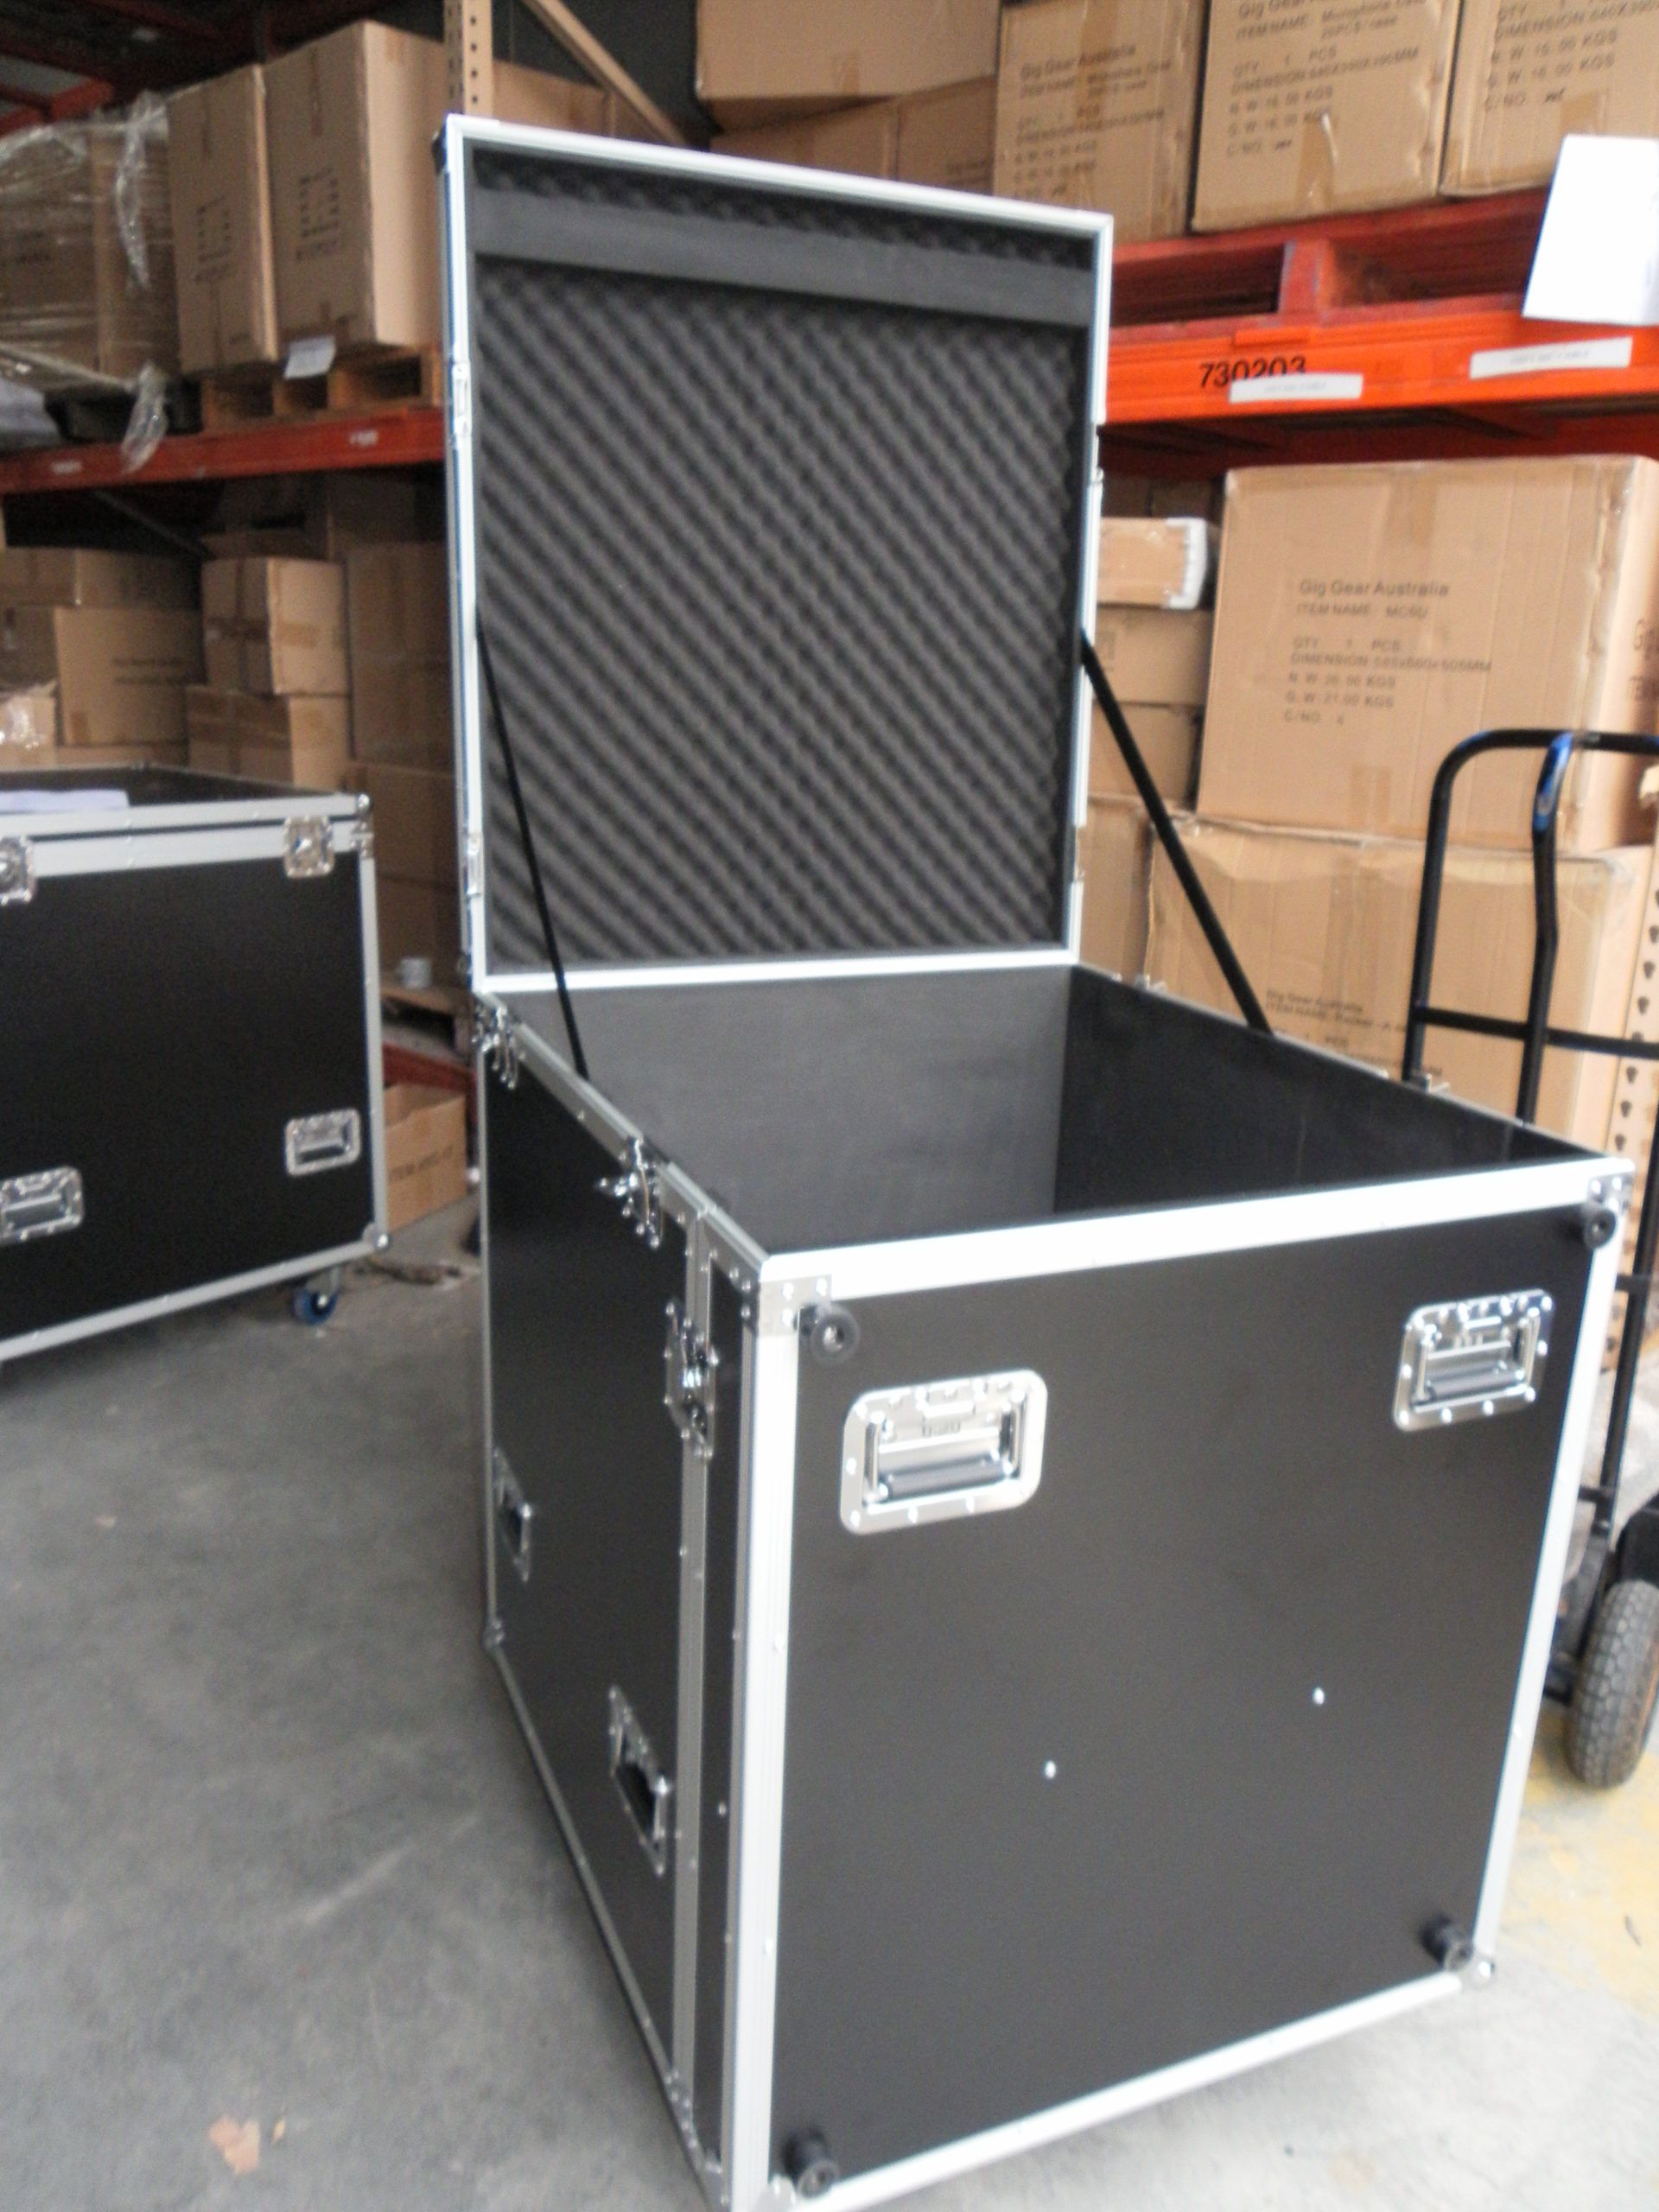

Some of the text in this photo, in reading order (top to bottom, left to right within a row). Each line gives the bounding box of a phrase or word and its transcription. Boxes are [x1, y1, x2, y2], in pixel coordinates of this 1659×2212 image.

[1200, 355, 1307, 388] 730203
[1300, 578, 1449, 598] Gig Gear Australia
